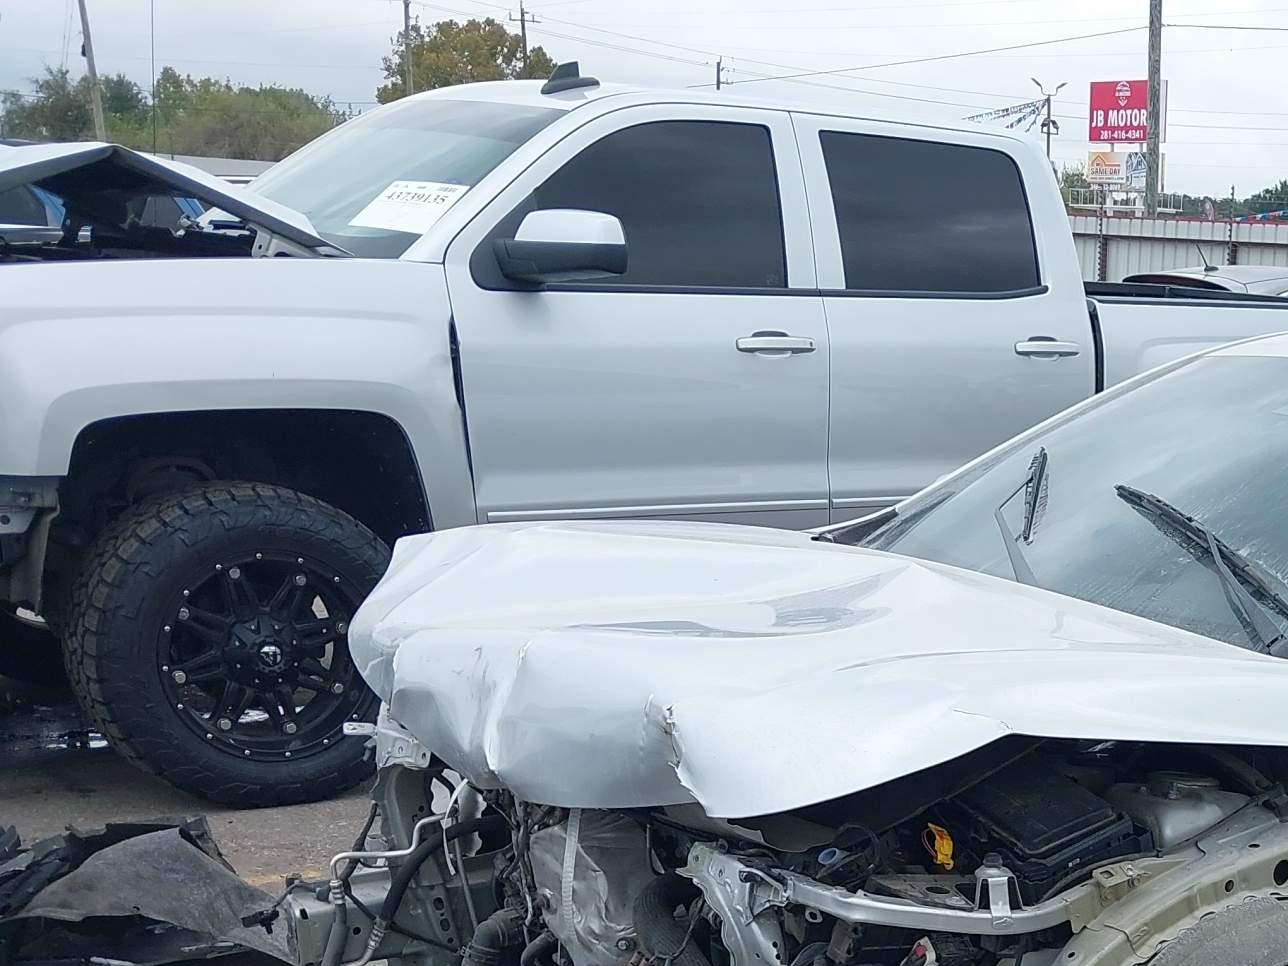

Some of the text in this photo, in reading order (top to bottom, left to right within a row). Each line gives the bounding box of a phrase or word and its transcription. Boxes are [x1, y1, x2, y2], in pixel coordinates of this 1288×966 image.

[1091, 109, 1105, 128] JB
[1100, 129, 1144, 140] 281-416-4341
[1090, 167, 1107, 175] SAME
